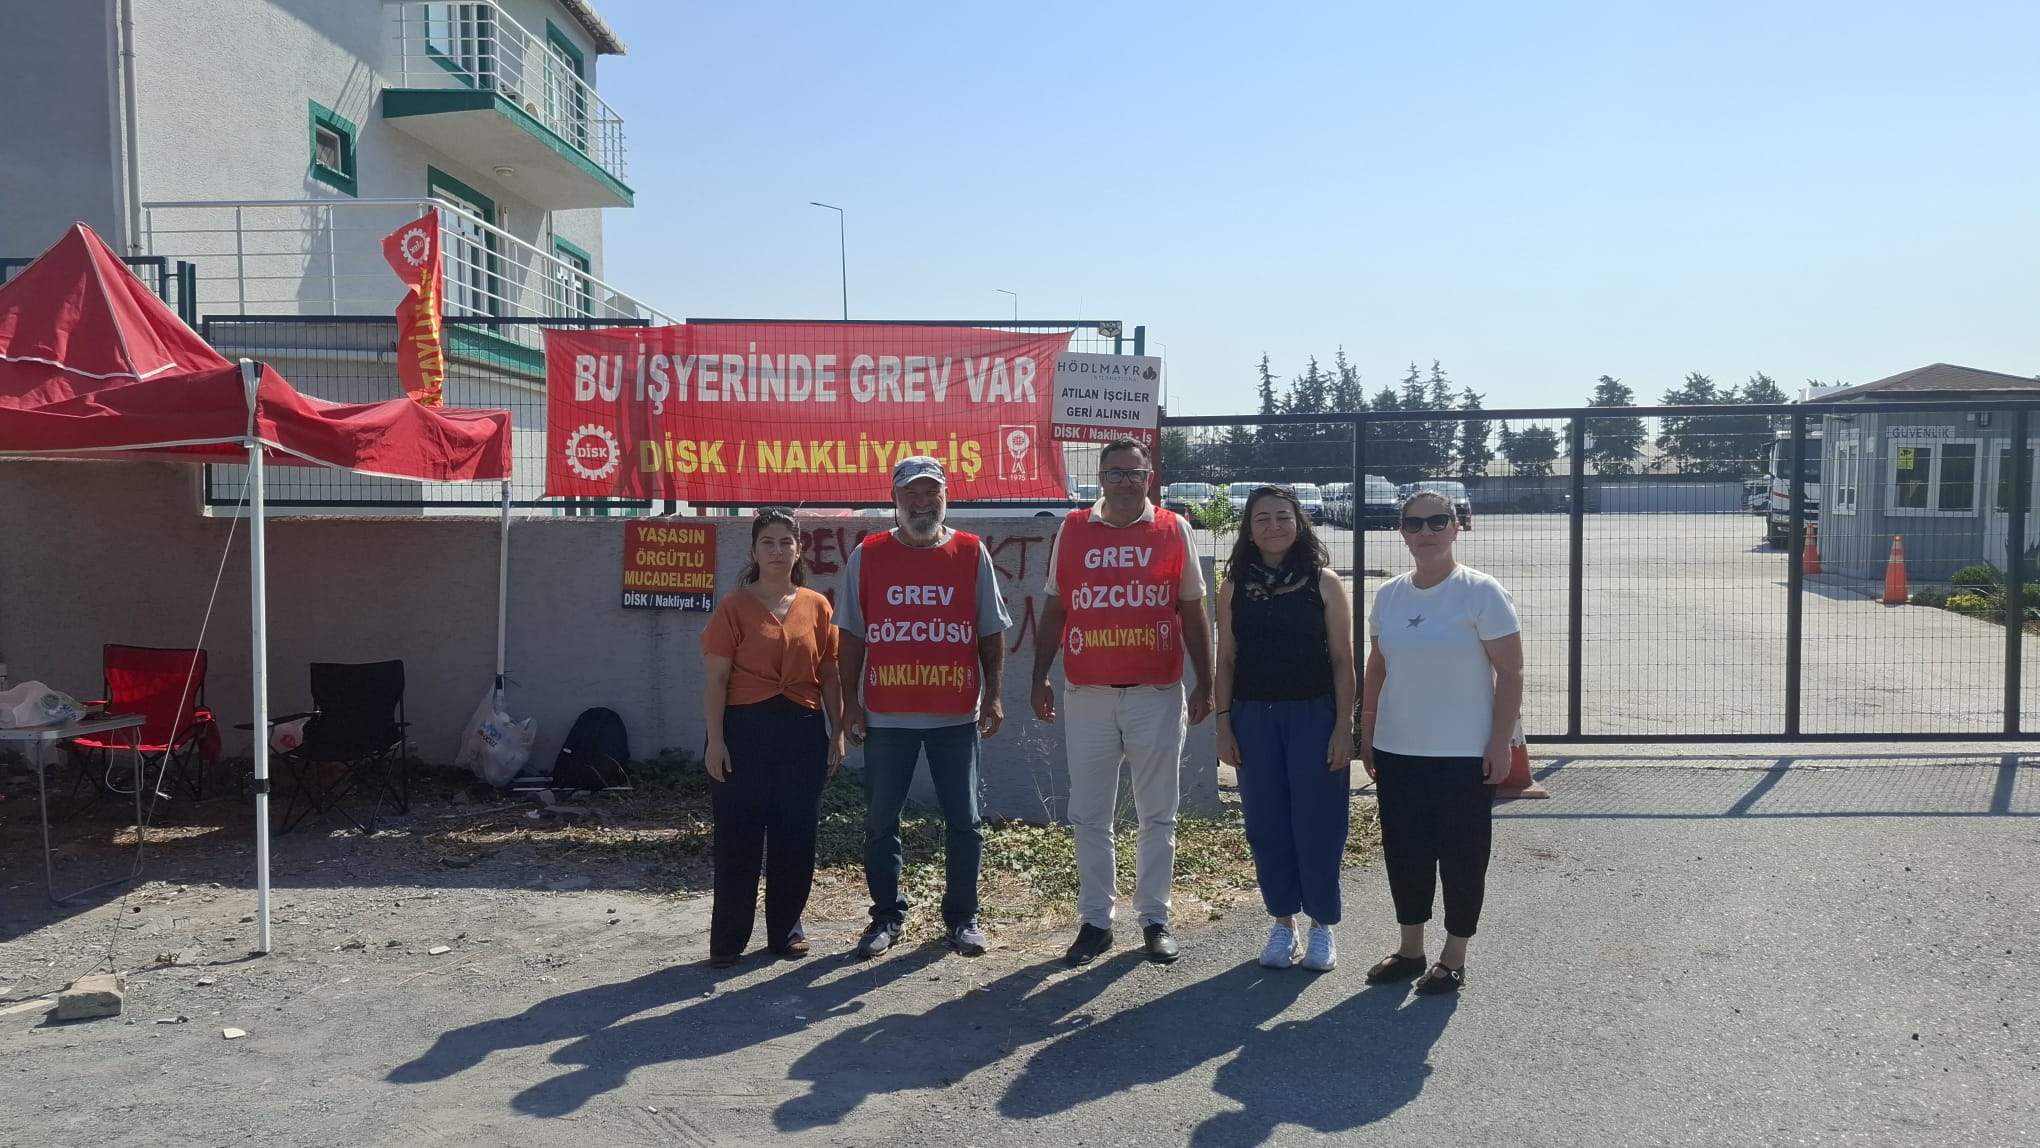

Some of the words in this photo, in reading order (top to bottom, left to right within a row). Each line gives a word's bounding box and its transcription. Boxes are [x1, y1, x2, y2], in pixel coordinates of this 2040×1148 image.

[1057, 360, 1140, 376] HÖDLMAYR
[575, 355, 623, 402] BU
[636, 342, 837, 415] İŞYERİNDE
[849, 354, 952, 402] GREV
[964, 357, 1037, 403] VAR
[1061, 388, 1099, 400] ATILAN
[1066, 406, 1092, 418] GERİ
[1095, 408, 1140, 420] ALINSIN
[1054, 424, 1080, 439] DİSK
[577, 443, 608, 458] DİSK
[640, 432, 726, 473] DİSK
[736, 440, 745, 473] /
[758, 432, 982, 482] NAKLİYAT-İŞ
[637, 527, 705, 546] YAŞASIN
[635, 547, 705, 567] ÖRGÜTLÜ
[1084, 546, 1153, 569] GREV
[624, 591, 648, 606] DİSK
[655, 594, 694, 610] Nakliyat
[886, 585, 954, 606] GREV
[1071, 580, 1171, 611] GÖZCÜSÜ
[867, 618, 973, 644] GÖZCÜSÜ
[1085, 624, 1156, 650] NAKLİYAT-İŞ
[879, 660, 964, 692] NAKLİYAT-İŞ
